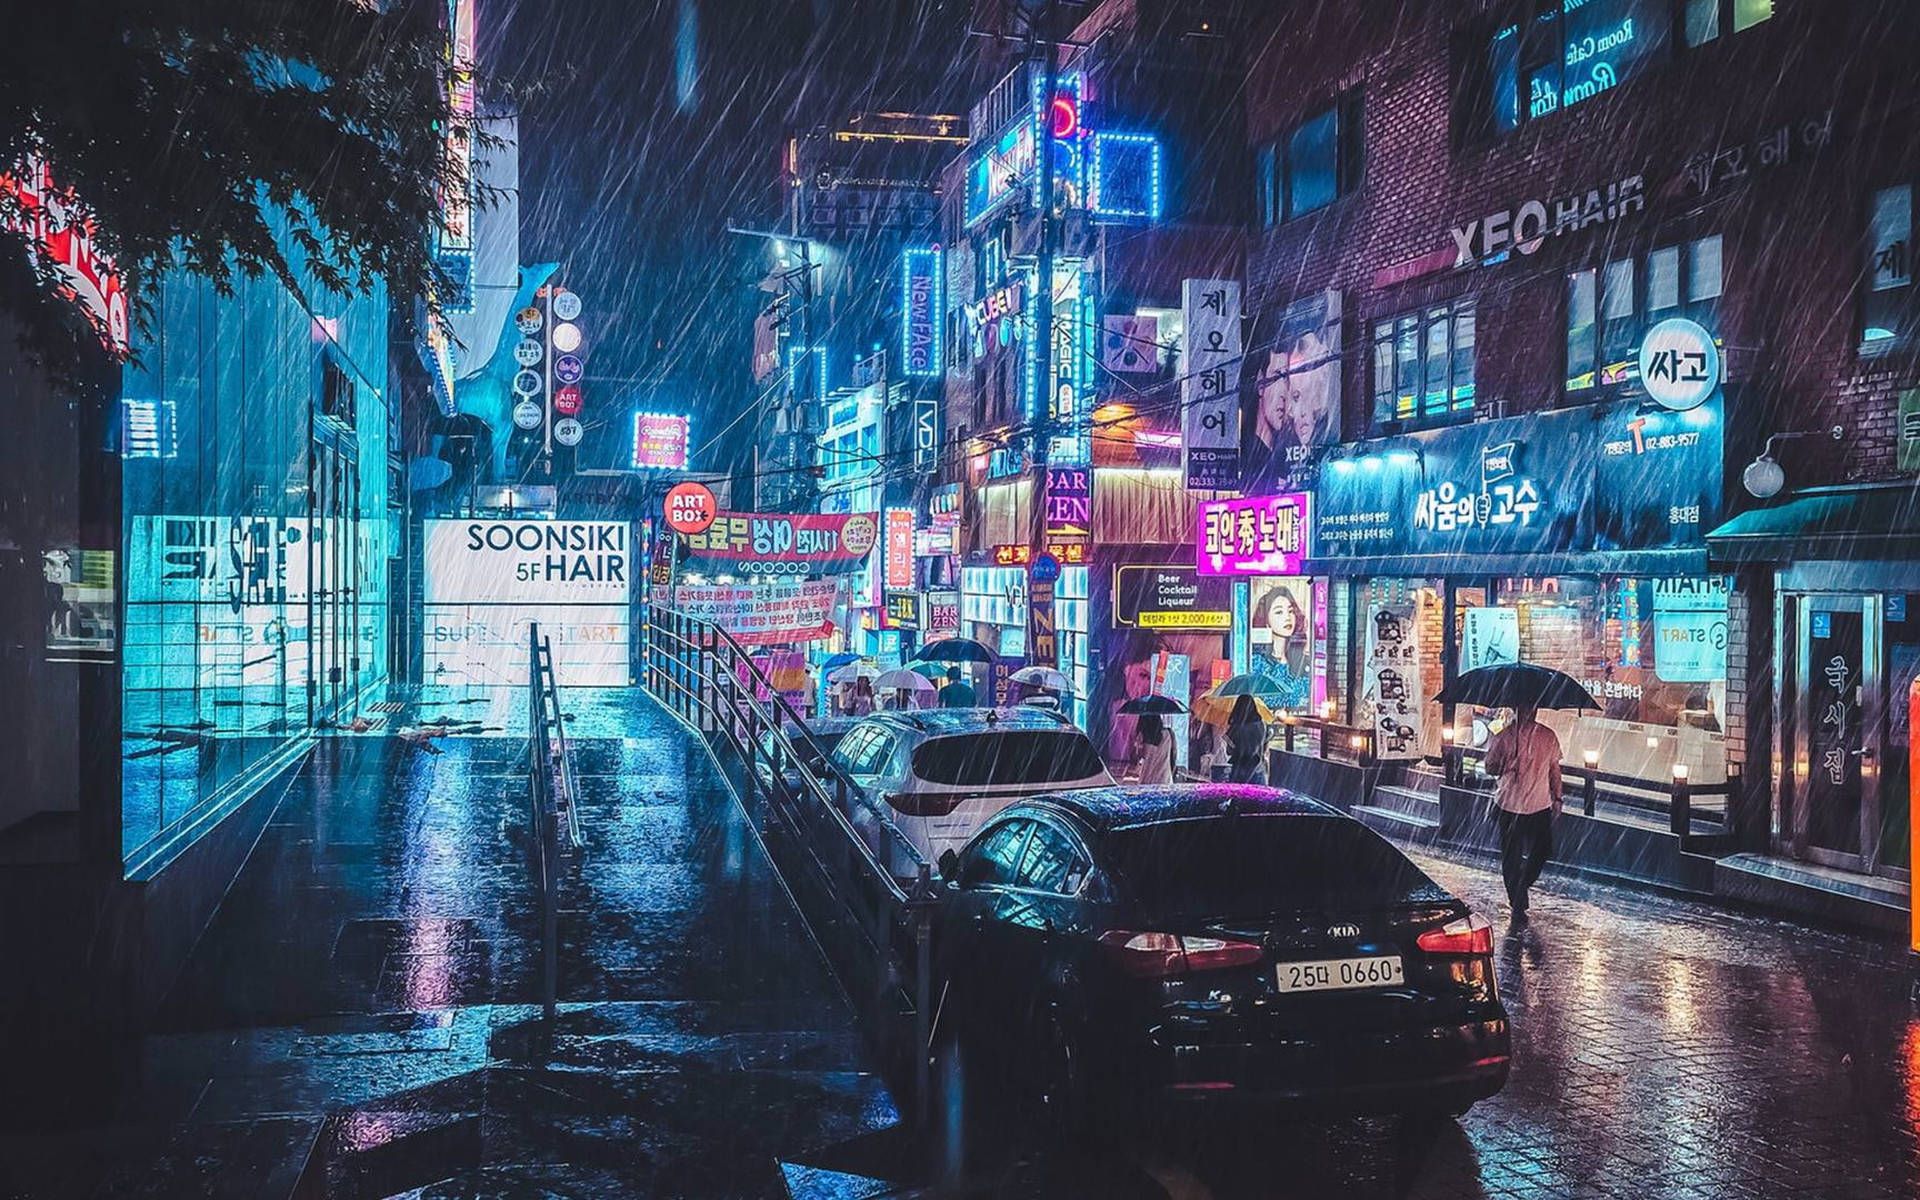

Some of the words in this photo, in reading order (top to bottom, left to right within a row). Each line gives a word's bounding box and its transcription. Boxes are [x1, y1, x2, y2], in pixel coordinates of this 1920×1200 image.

[1556, 175, 1644, 236] HAIR
[1201, 288, 1229, 438] 제오헤어
[1647, 349, 1710, 384] 싸고
[1191, 451, 1217, 462] XEO
[1047, 472, 1087, 490] BAR
[672, 495, 706, 508] ART
[1415, 482, 1475, 532] 싸움의
[1491, 480, 1540, 528] 고수
[672, 510, 706, 523] BOX
[1669, 505, 1699, 524] 홍대점
[467, 524, 624, 551] SOONSIKI
[516, 563, 541, 581] 5F
[546, 554, 625, 582] HAIR
[1158, 574, 1180, 584] Beer
[1158, 585, 1198, 595] Cocktail
[1158, 596, 1194, 608] Liqueur
[933, 606, 957, 617] BAR
[933, 616, 957, 627] ZEN
[1823, 655, 1849, 786] 국시집
[1333, 926, 1356, 938] KIA
[1340, 960, 1392, 984] 0660
